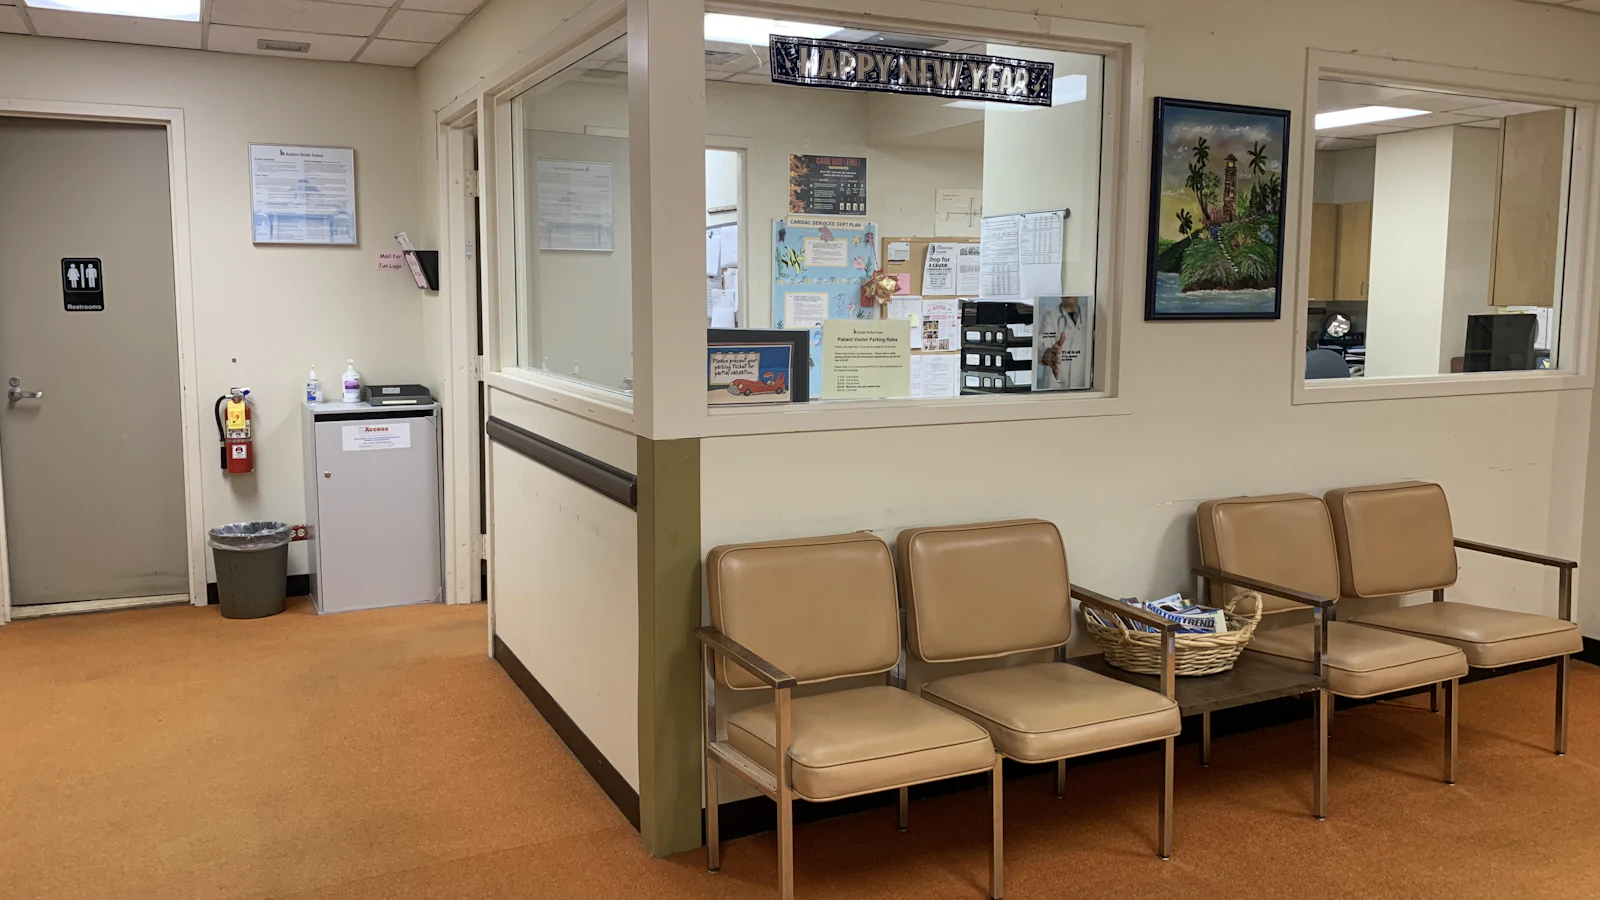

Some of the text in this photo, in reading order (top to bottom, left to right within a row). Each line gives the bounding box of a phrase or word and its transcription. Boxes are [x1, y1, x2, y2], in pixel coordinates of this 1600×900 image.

[798, 46, 894, 84] HAPPY
[900, 55, 964, 90] NEW
[968, 62, 1030, 97] YEAR
[67, 303, 102, 311] Restrooms
